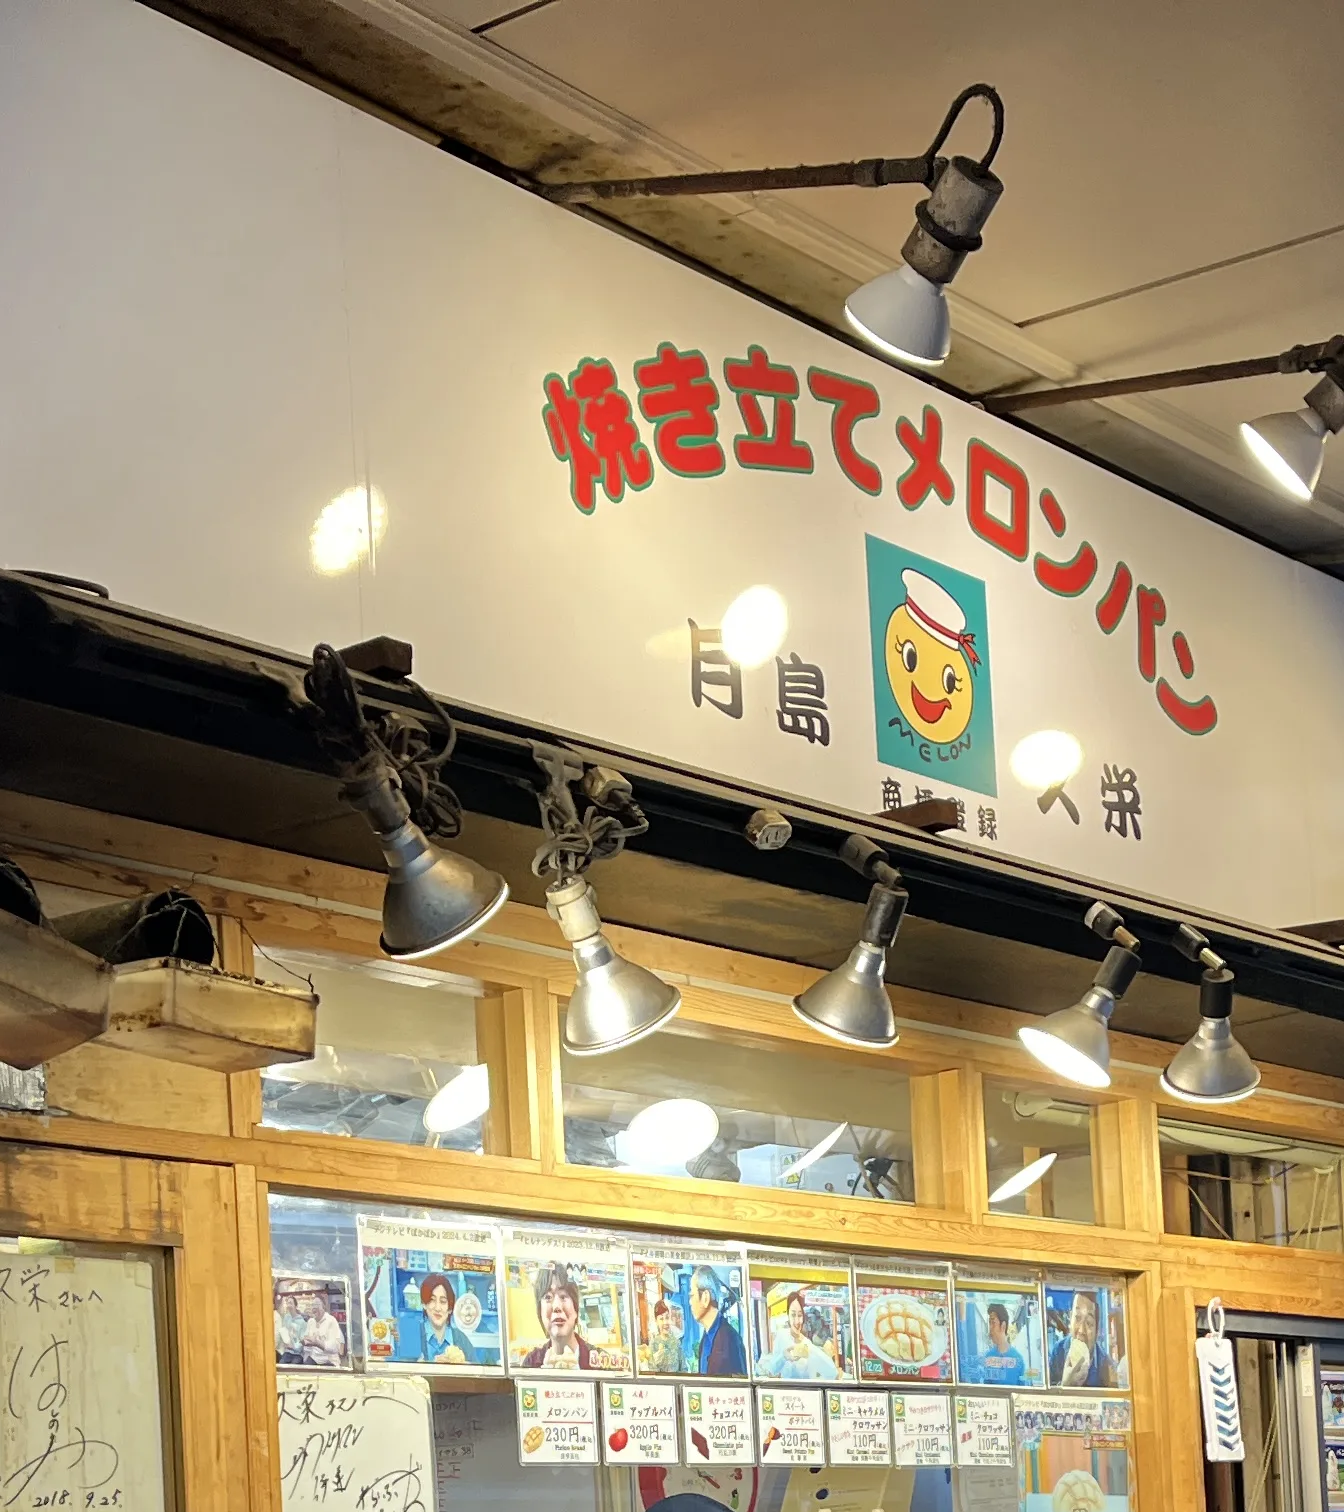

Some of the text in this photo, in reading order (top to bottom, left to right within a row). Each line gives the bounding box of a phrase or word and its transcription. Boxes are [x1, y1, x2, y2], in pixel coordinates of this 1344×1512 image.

[542, 341, 1218, 736] 焼き立てメロンパン
